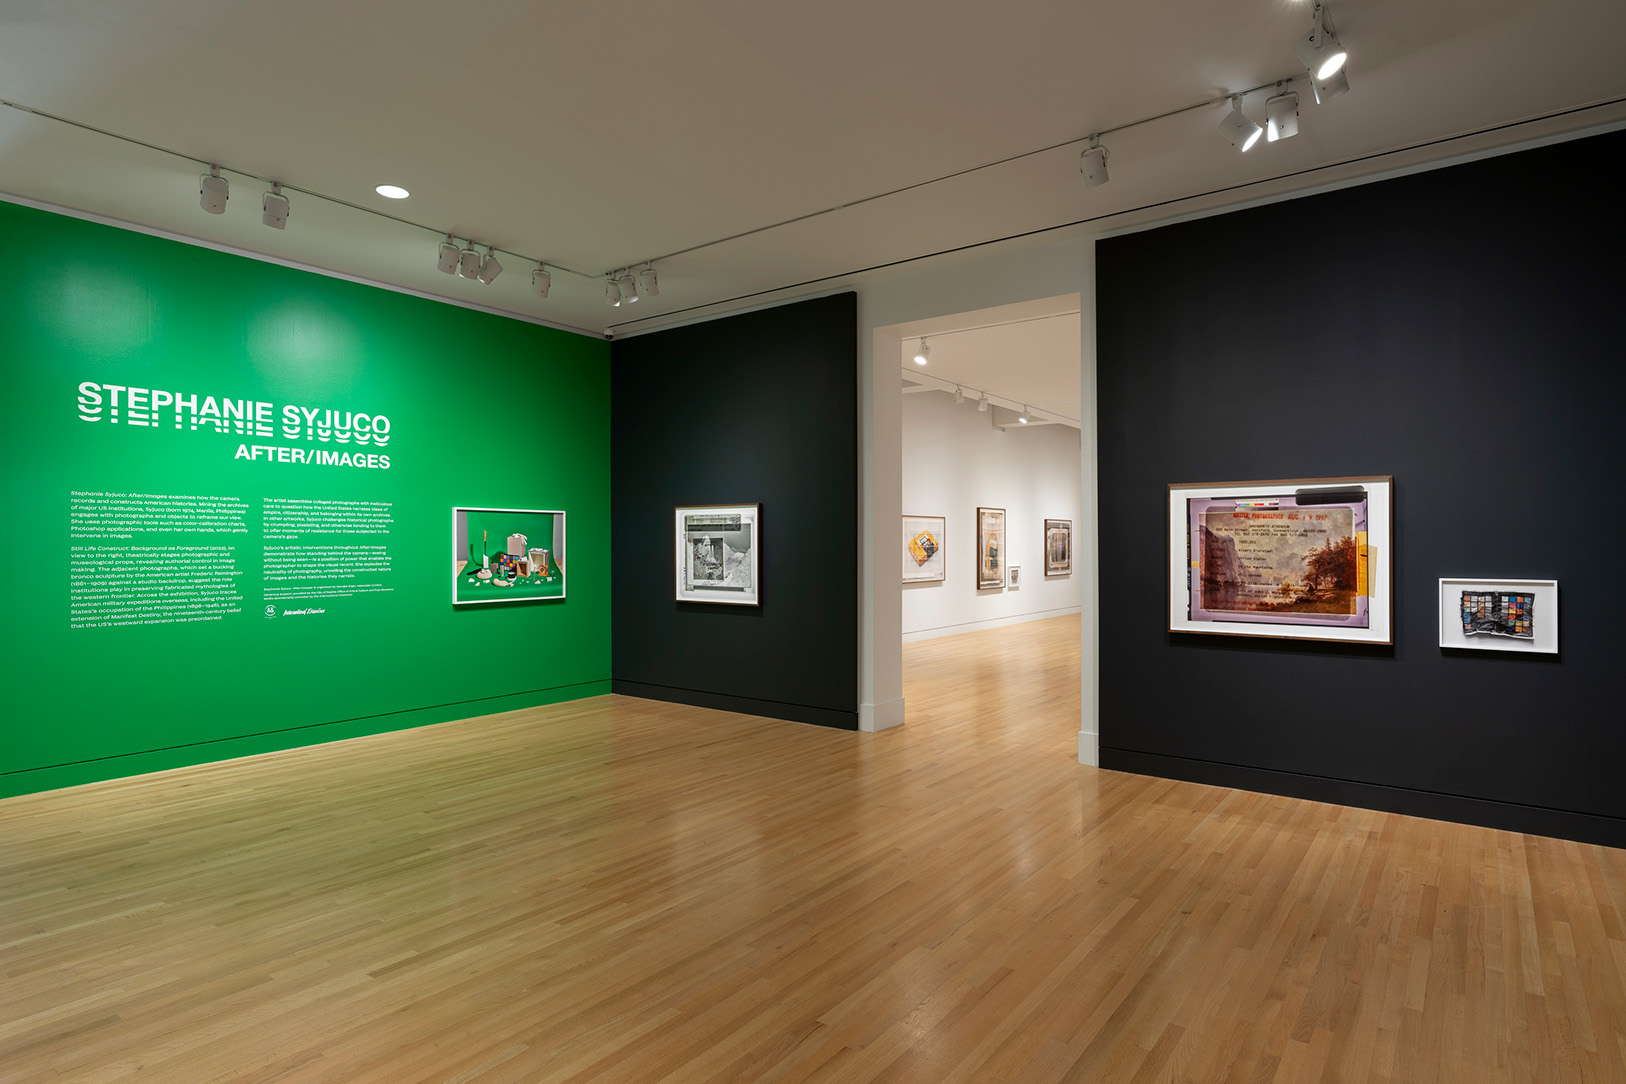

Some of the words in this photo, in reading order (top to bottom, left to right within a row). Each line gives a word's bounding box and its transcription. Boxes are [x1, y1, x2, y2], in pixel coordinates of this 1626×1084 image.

[78, 382, 273, 437] STEPHANIE
[282, 405, 390, 446] SYJUCO
[234, 444, 390, 469] AFTER/IMAGES
